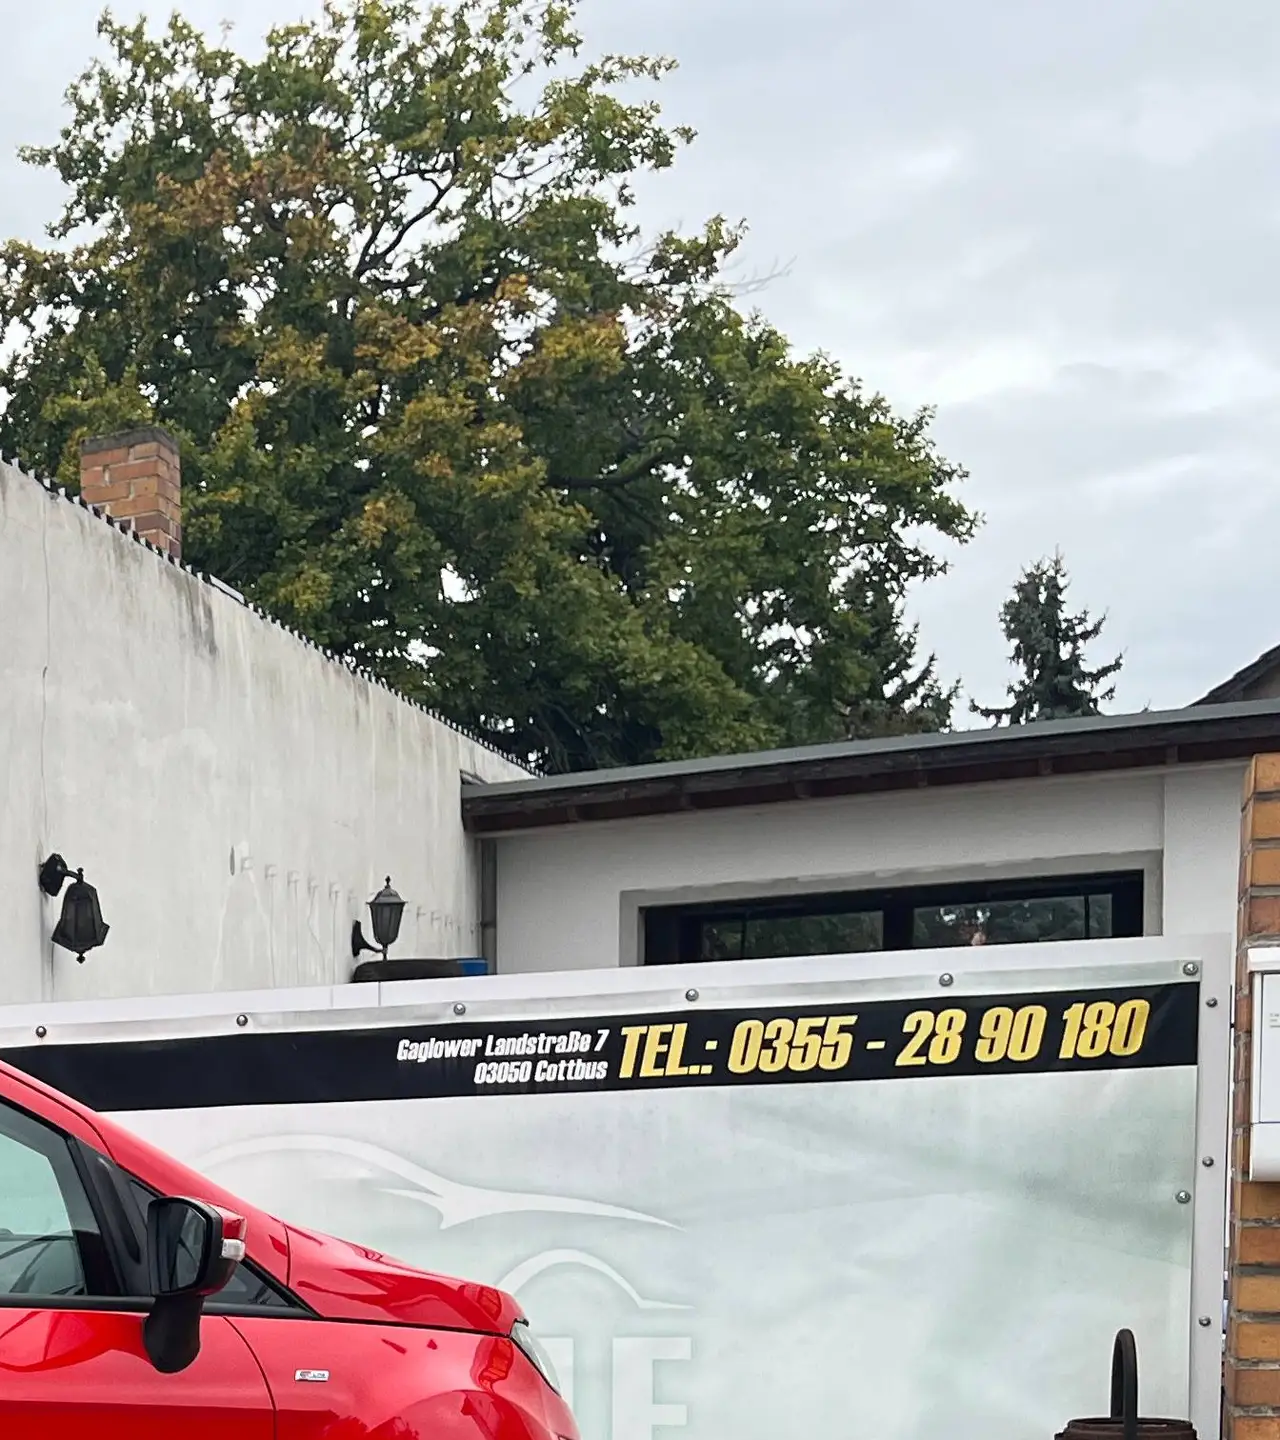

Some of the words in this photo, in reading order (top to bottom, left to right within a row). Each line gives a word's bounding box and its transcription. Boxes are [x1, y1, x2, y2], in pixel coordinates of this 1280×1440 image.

[396, 1037, 482, 1063] Gaglower
[484, 1031, 592, 1057] Landstraße
[594, 1029, 610, 1051] 7
[618, 1020, 718, 1079] TEL.:
[726, 1014, 859, 1074] 0355
[865, 1040, 885, 1050] -
[894, 1008, 967, 1068] 28
[974, 1003, 1048, 1062] 90
[1057, 998, 1151, 1060] 180
[473, 1062, 533, 1084] 03050
[534, 1060, 609, 1082] Cottbus
